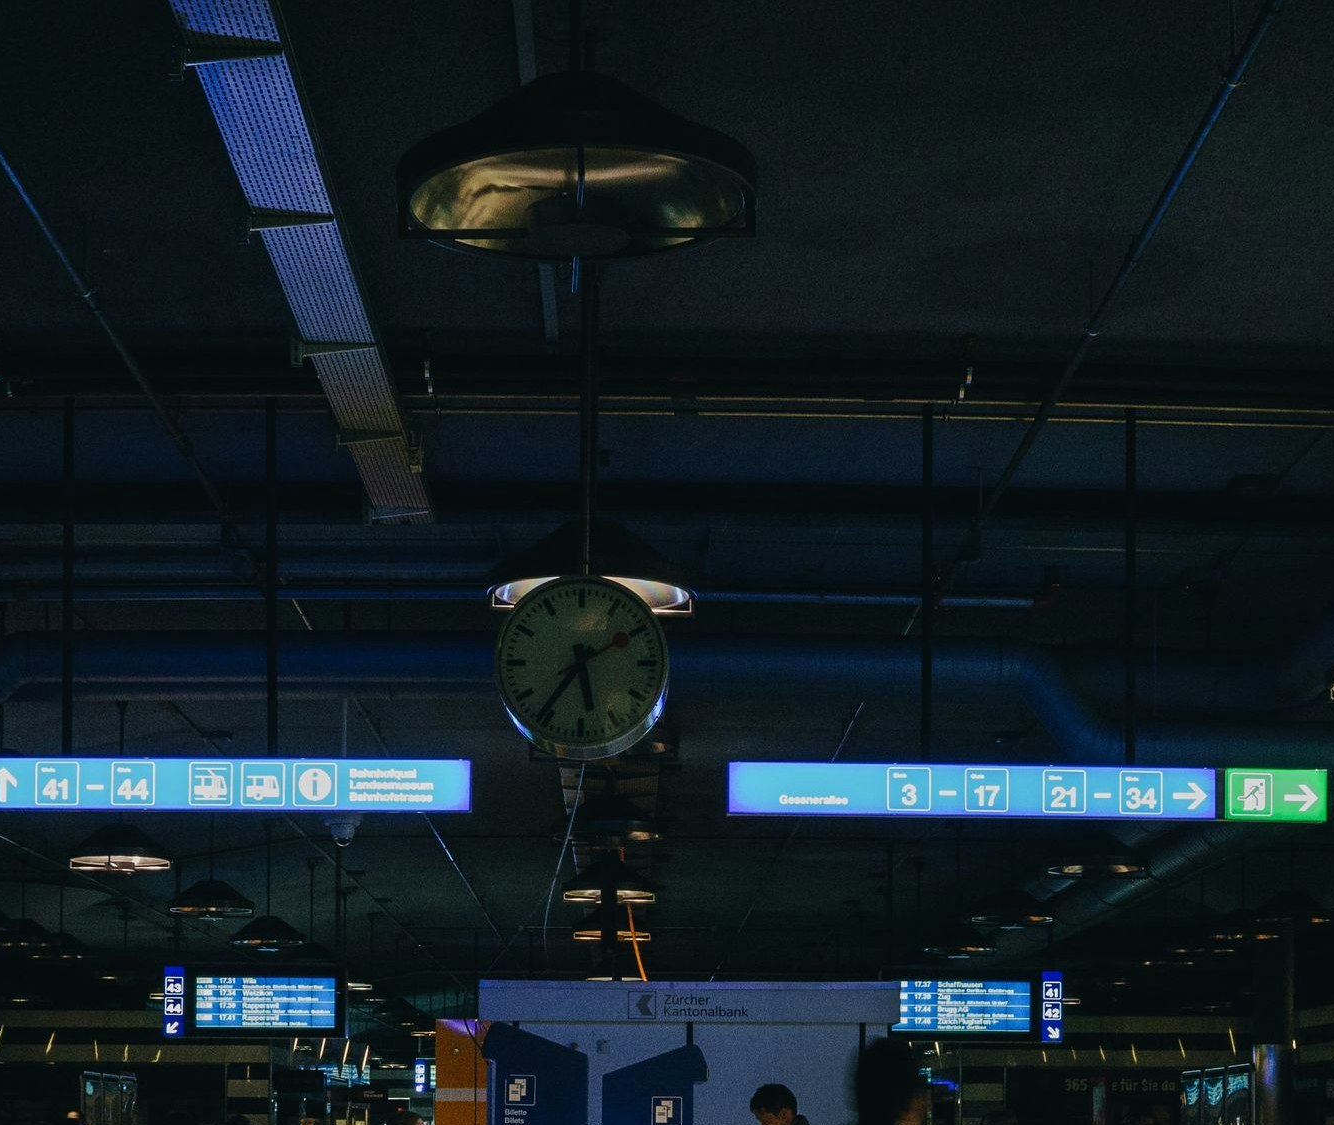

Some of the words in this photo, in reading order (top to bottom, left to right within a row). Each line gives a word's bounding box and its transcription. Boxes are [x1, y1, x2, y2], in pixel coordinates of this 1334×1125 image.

[42, 778, 69, 800] 41
[116, 778, 149, 800] 44
[901, 783, 917, 806] 3
[973, 785, 1001, 807] 17
[1051, 786, 1077, 808] 21
[1125, 787, 1157, 809] 34
[167, 983, 182, 993] 43
[1045, 987, 1059, 998] 41
[664, 994, 710, 1005] Zürcher
[167, 1003, 182, 1013] 44
[664, 1005, 749, 1017] Kantonalbank
[1044, 1008, 1060, 1018] 42
[504, 1108, 528, 1116] Billette
[504, 1116, 525, 1124] Billets
